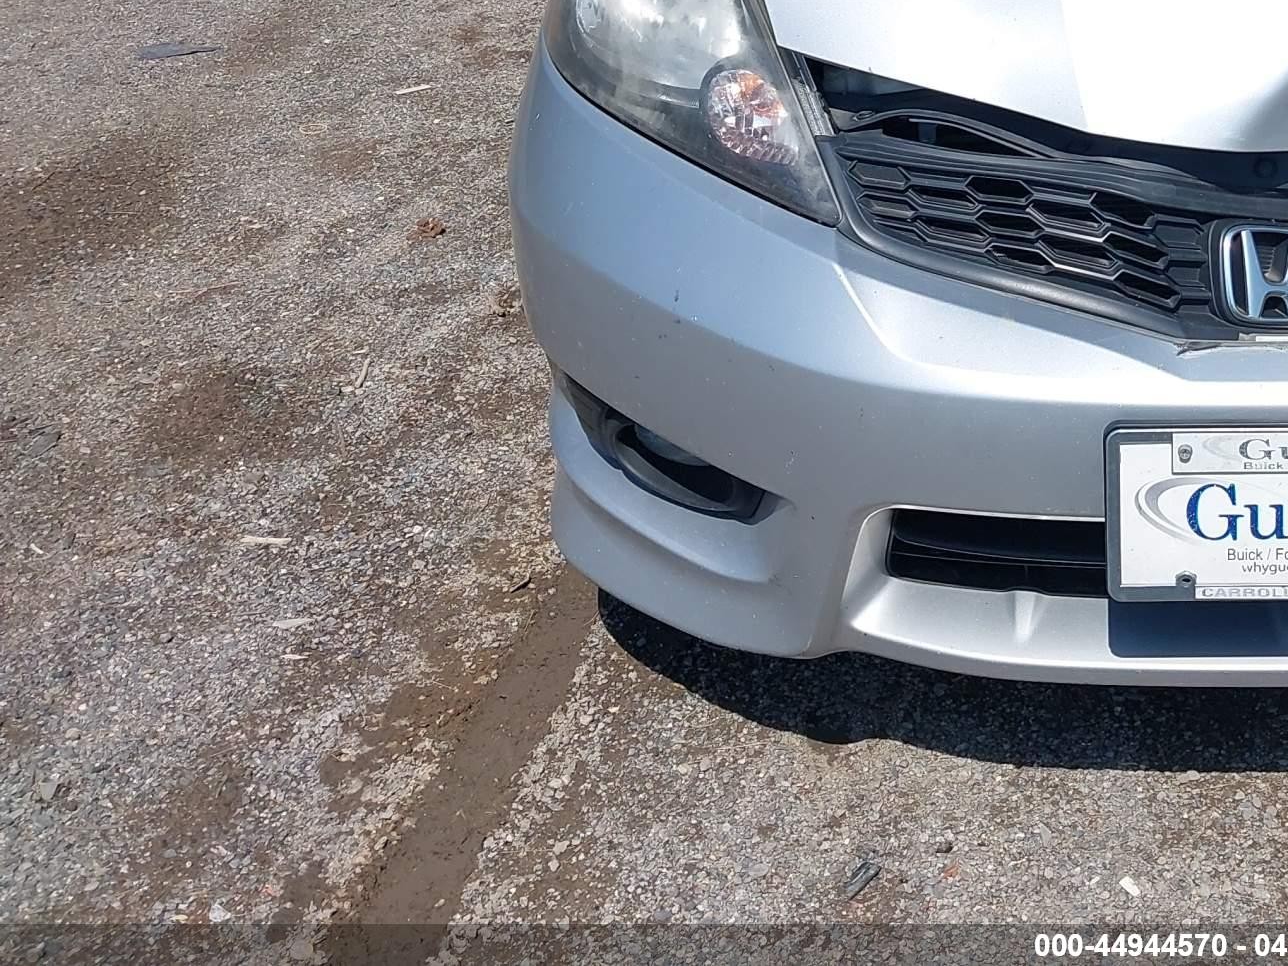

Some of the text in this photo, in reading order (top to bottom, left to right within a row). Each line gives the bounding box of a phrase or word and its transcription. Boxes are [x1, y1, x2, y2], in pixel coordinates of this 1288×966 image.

[1243, 461, 1283, 470] Buick
[1227, 548, 1263, 561] Buick
[1266, 547, 1272, 561] /
